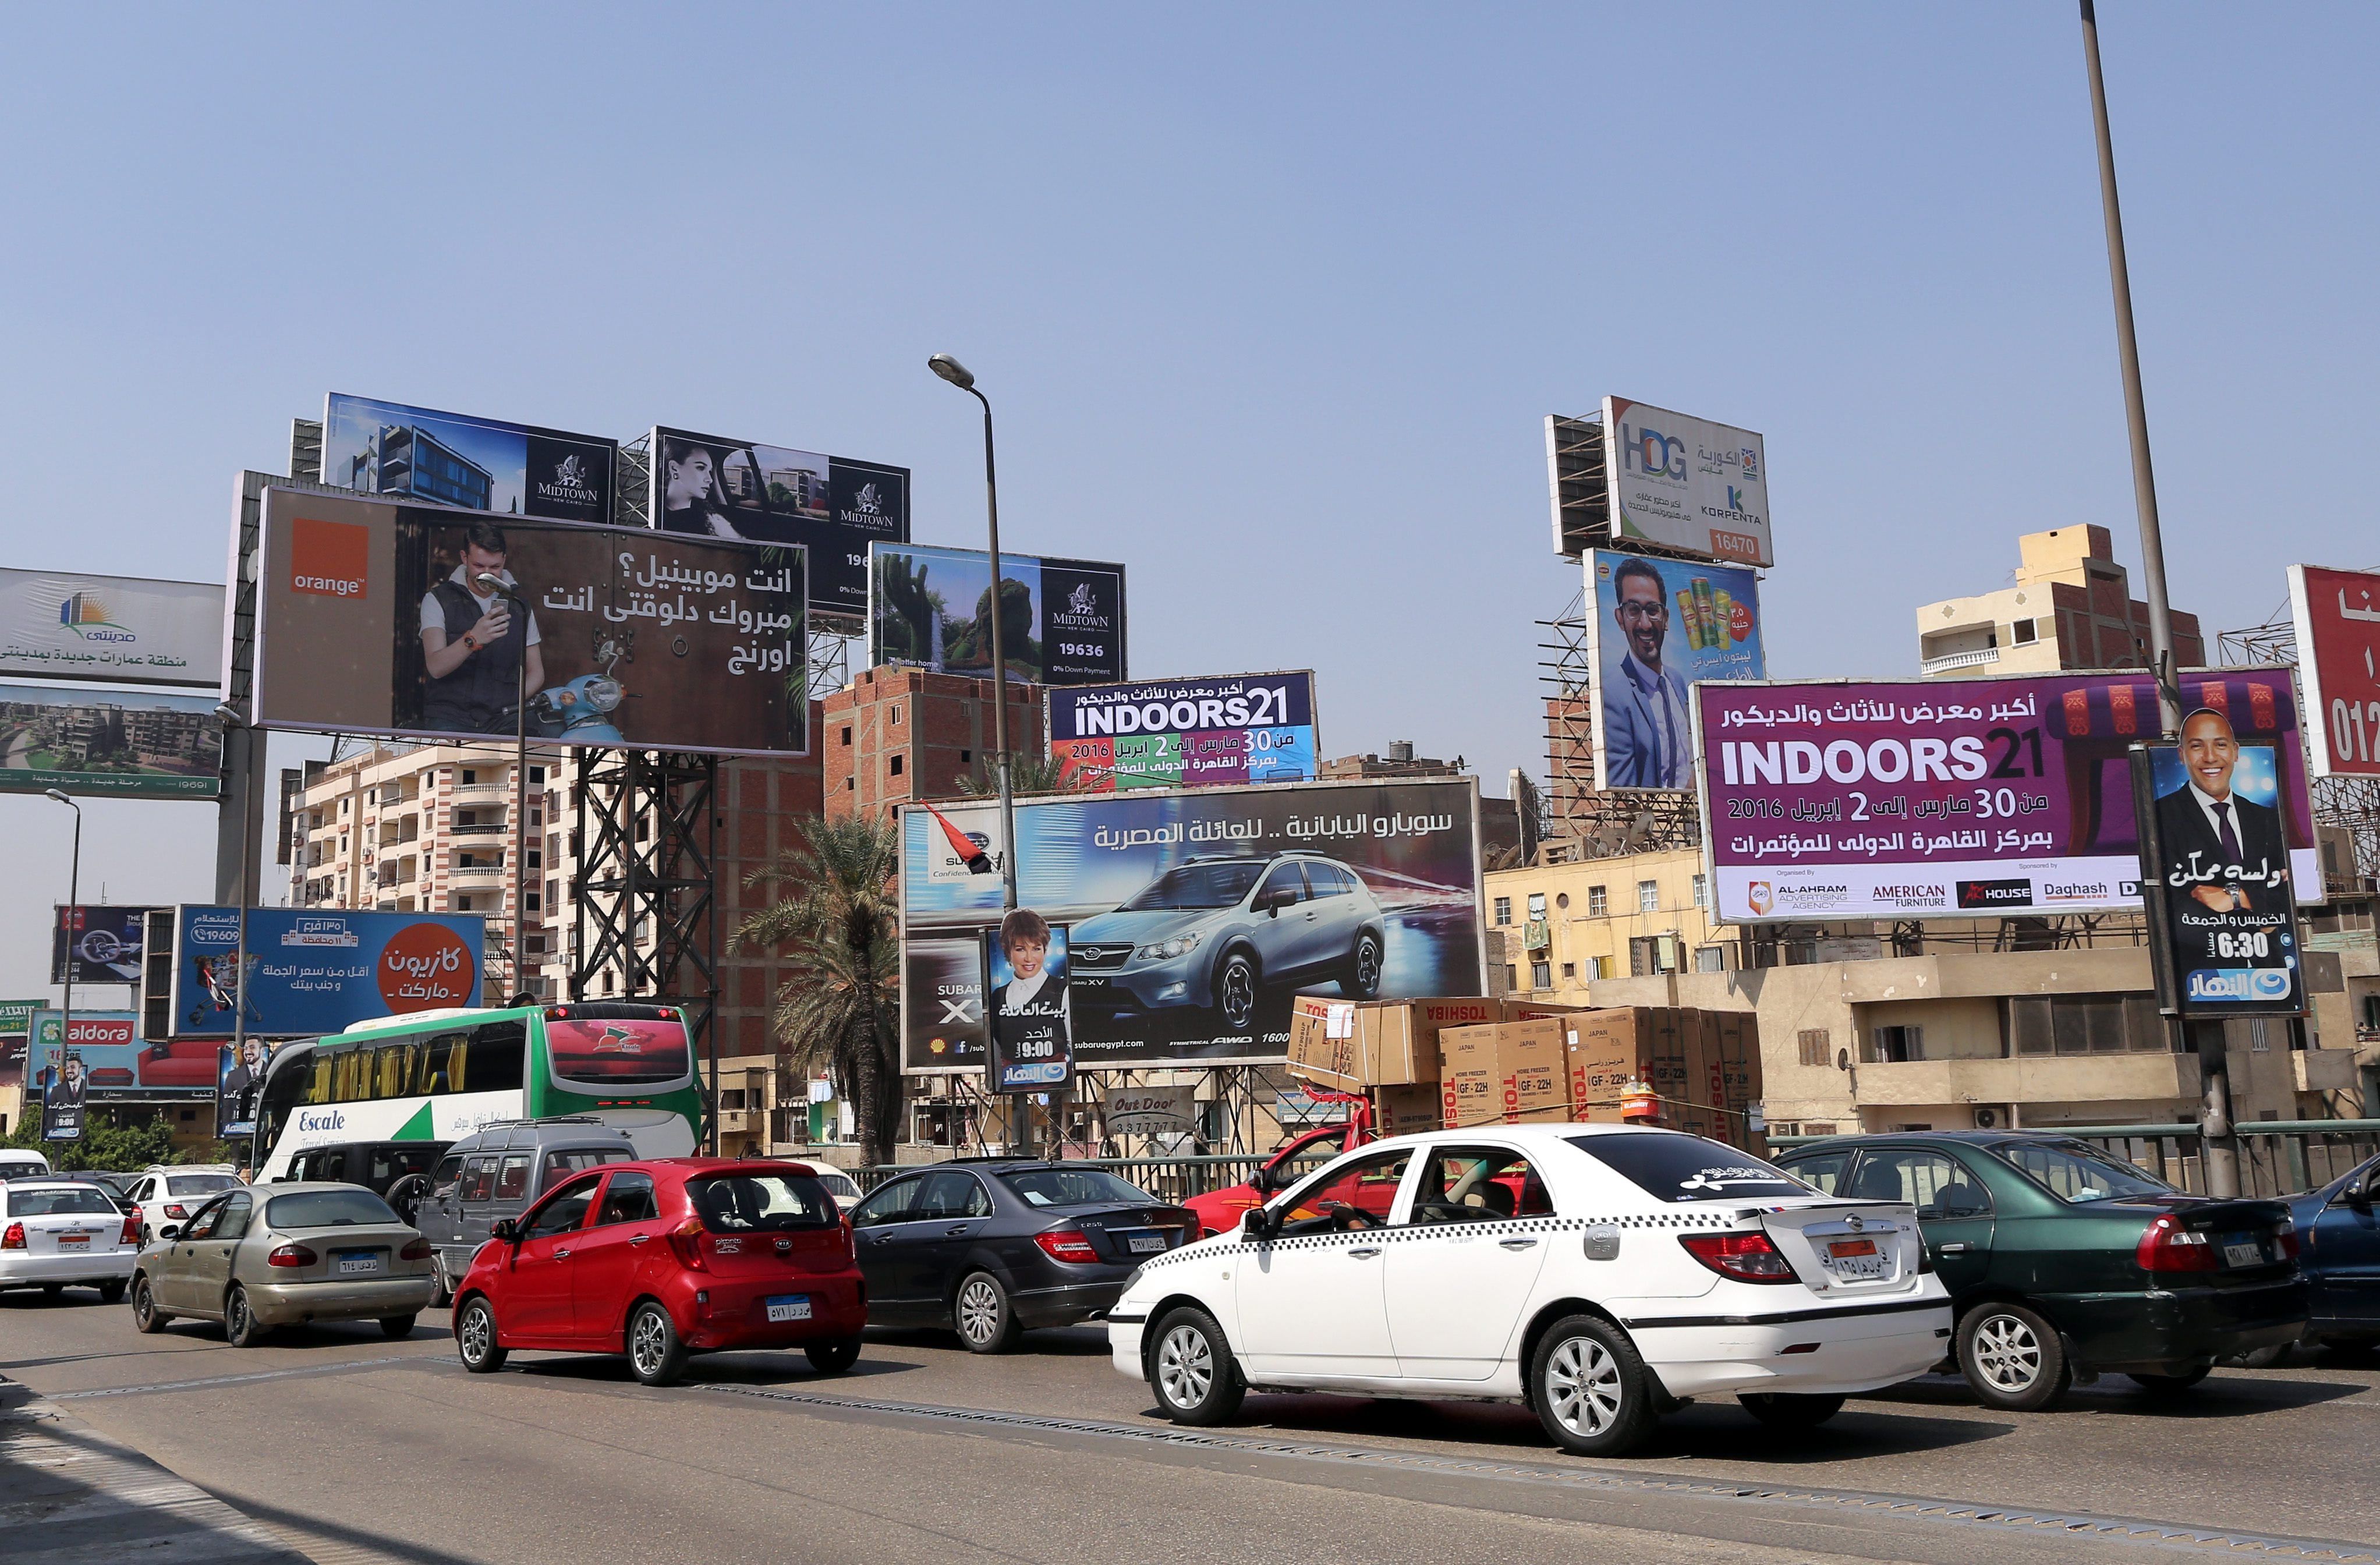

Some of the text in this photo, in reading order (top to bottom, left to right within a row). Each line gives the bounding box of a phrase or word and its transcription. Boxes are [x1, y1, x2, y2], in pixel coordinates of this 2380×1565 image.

[1623, 423, 1687, 482] HDG
[538, 483, 597, 501] MIDTOWN
[841, 509, 893, 526] MIDTOWN
[1701, 506, 1762, 525] KORPENTA
[1716, 533, 1754, 554] 16470
[847, 554, 867, 567] 196
[295, 575, 358, 595] orange
[746, 568, 791, 592] انت
[543, 586, 791, 635] مبروك دلوقتى انت
[1053, 612, 1108, 626] MIDTOWN
[1731, 620, 1748, 630] جنيه
[54, 649, 96, 665] جديدة
[1060, 643, 1104, 657] 19636
[1724, 650, 1751, 664] ليبتون
[100, 652, 143, 666] عمارات
[148, 654, 186, 667] منطقة
[1075, 681, 1243, 706] أكبر معرض للأثاث والديكور
[1721, 692, 2036, 728] أكبر معرض للأثاث والديكور
[1071, 730, 1294, 759] من 30 مارس إلى 2 إبريل 2016
[1149, 759, 1188, 774] الدولى
[1193, 756, 1237, 773] القاهرة
[1242, 756, 1277, 770] بمركز
[1727, 787, 2048, 822] من 30 مارس إلى 2 إبريل 2016
[1094, 813, 1453, 851] سوبارو اليابانية للعائلة المصرية
[1731, 828, 2053, 859] بمركز القاهرة الدولى للمؤتمرات
[1779, 886, 1847, 894] AL-AHRAM
[1873, 885, 1945, 898] AMERICAN
[1985, 888, 2031, 899] HOUSE
[2045, 882, 2107, 898] Daghash
[1896, 898, 1946, 907] FURNITURE
[303, 920, 321, 933] فرع
[2181, 913, 2226, 927] الجمعة
[2237, 913, 2286, 927] الخميس
[206, 930, 239, 940] 19609
[302, 936, 334, 944] محافظة
[2218, 932, 2269, 958] 6:30
[387, 947, 461, 978] كازيون
[263, 965, 369, 978] أقل من سعر الجملة
[291, 979, 341, 991] و جنب بيتك
[399, 982, 449, 999] ماركت
[938, 985, 982, 996] SUBAR
[2190, 973, 2250, 997] النهار
[1040, 1001, 1065, 1018] بيت
[1427, 1006, 1488, 1020] TOSHIBA
[68, 1025, 129, 1040] aldora
[1025, 1026, 1053, 1039] الأحد
[1211, 1036, 1252, 1044] AWD
[1022, 1040, 1053, 1058] 9:00
[1075, 1039, 1143, 1050] subaruegypt.com
[1004, 1067, 1040, 1082] النهار
[1115, 1097, 1175, 1111] Out Door
[299, 1110, 345, 1131] Escale
